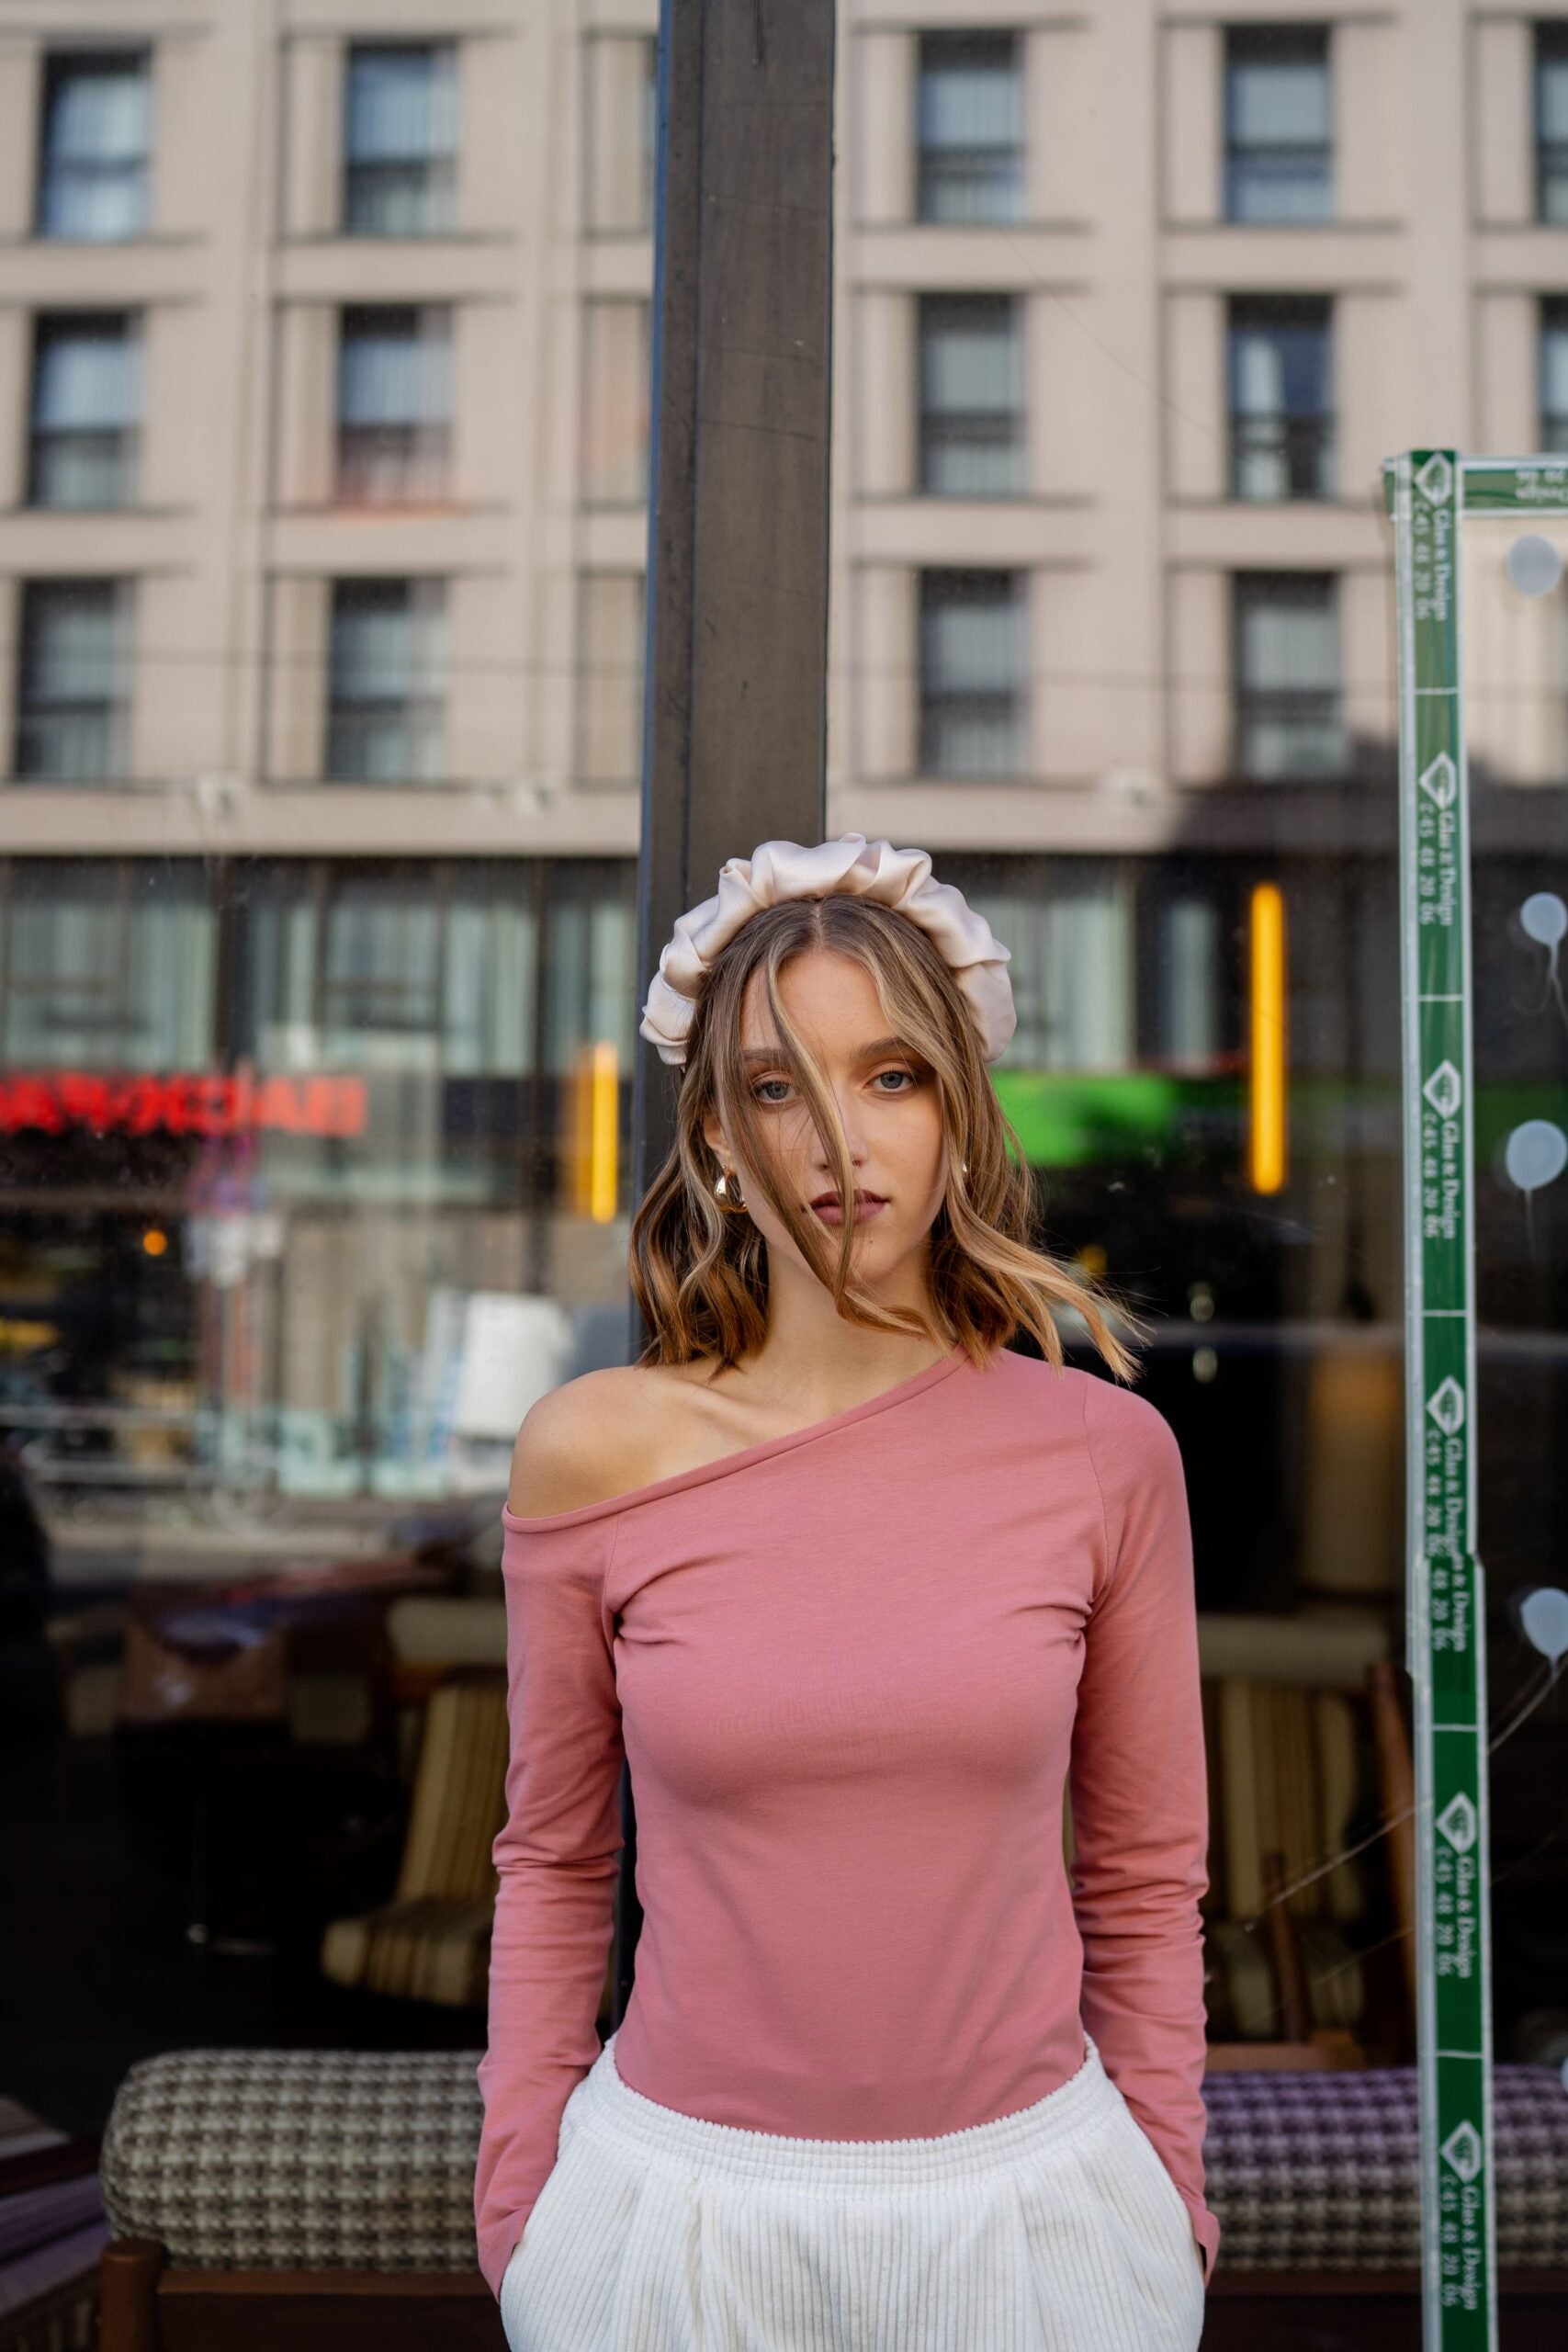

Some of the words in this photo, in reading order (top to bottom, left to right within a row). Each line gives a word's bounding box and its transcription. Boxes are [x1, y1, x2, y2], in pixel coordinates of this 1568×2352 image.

[1419, 818, 1434, 838] 45
[1438, 811, 1456, 849] Glas
[1420, 845, 1435, 866] 48
[1419, 875, 1436, 897] 20
[1436, 867, 1458, 926] Design
[1420, 902, 1436, 924] 06
[1423, 1127, 1438, 1148] 45
[1441, 1121, 1461, 1159] Glas
[1424, 1158, 1438, 1178] 48
[1424, 1187, 1438, 1208] 20
[1438, 1180, 1461, 1238] Design
[1424, 1215, 1438, 1238] 06
[1427, 1444, 1441, 1465] 45
[1445, 1438, 1464, 1476] Glas
[1427, 1474, 1442, 1496] 48
[1427, 1504, 1442, 1527] 20
[1427, 1533, 1442, 1555] 06
[1432, 1567, 1448, 1589] 48
[1432, 1599, 1448, 1621] 20
[1448, 1591, 1472, 1651] Design
[1432, 1627, 1450, 1650] 06
[1435, 1862, 1453, 1883] 45
[1456, 1856, 1476, 1895] Glas
[1436, 1892, 1453, 1914] 48
[1436, 1923, 1454, 1945] 20
[1451, 1917, 1477, 1978] Design
[1436, 1951, 1454, 1976] 06
[1441, 2191, 1459, 2211] 45
[1461, 2186, 1482, 2225] Glas
[1441, 2222, 1460, 2244] 48
[1441, 2254, 1460, 2275] 20
[1458, 2248, 1482, 2310] Design
[1441, 2283, 1461, 2306] 06
